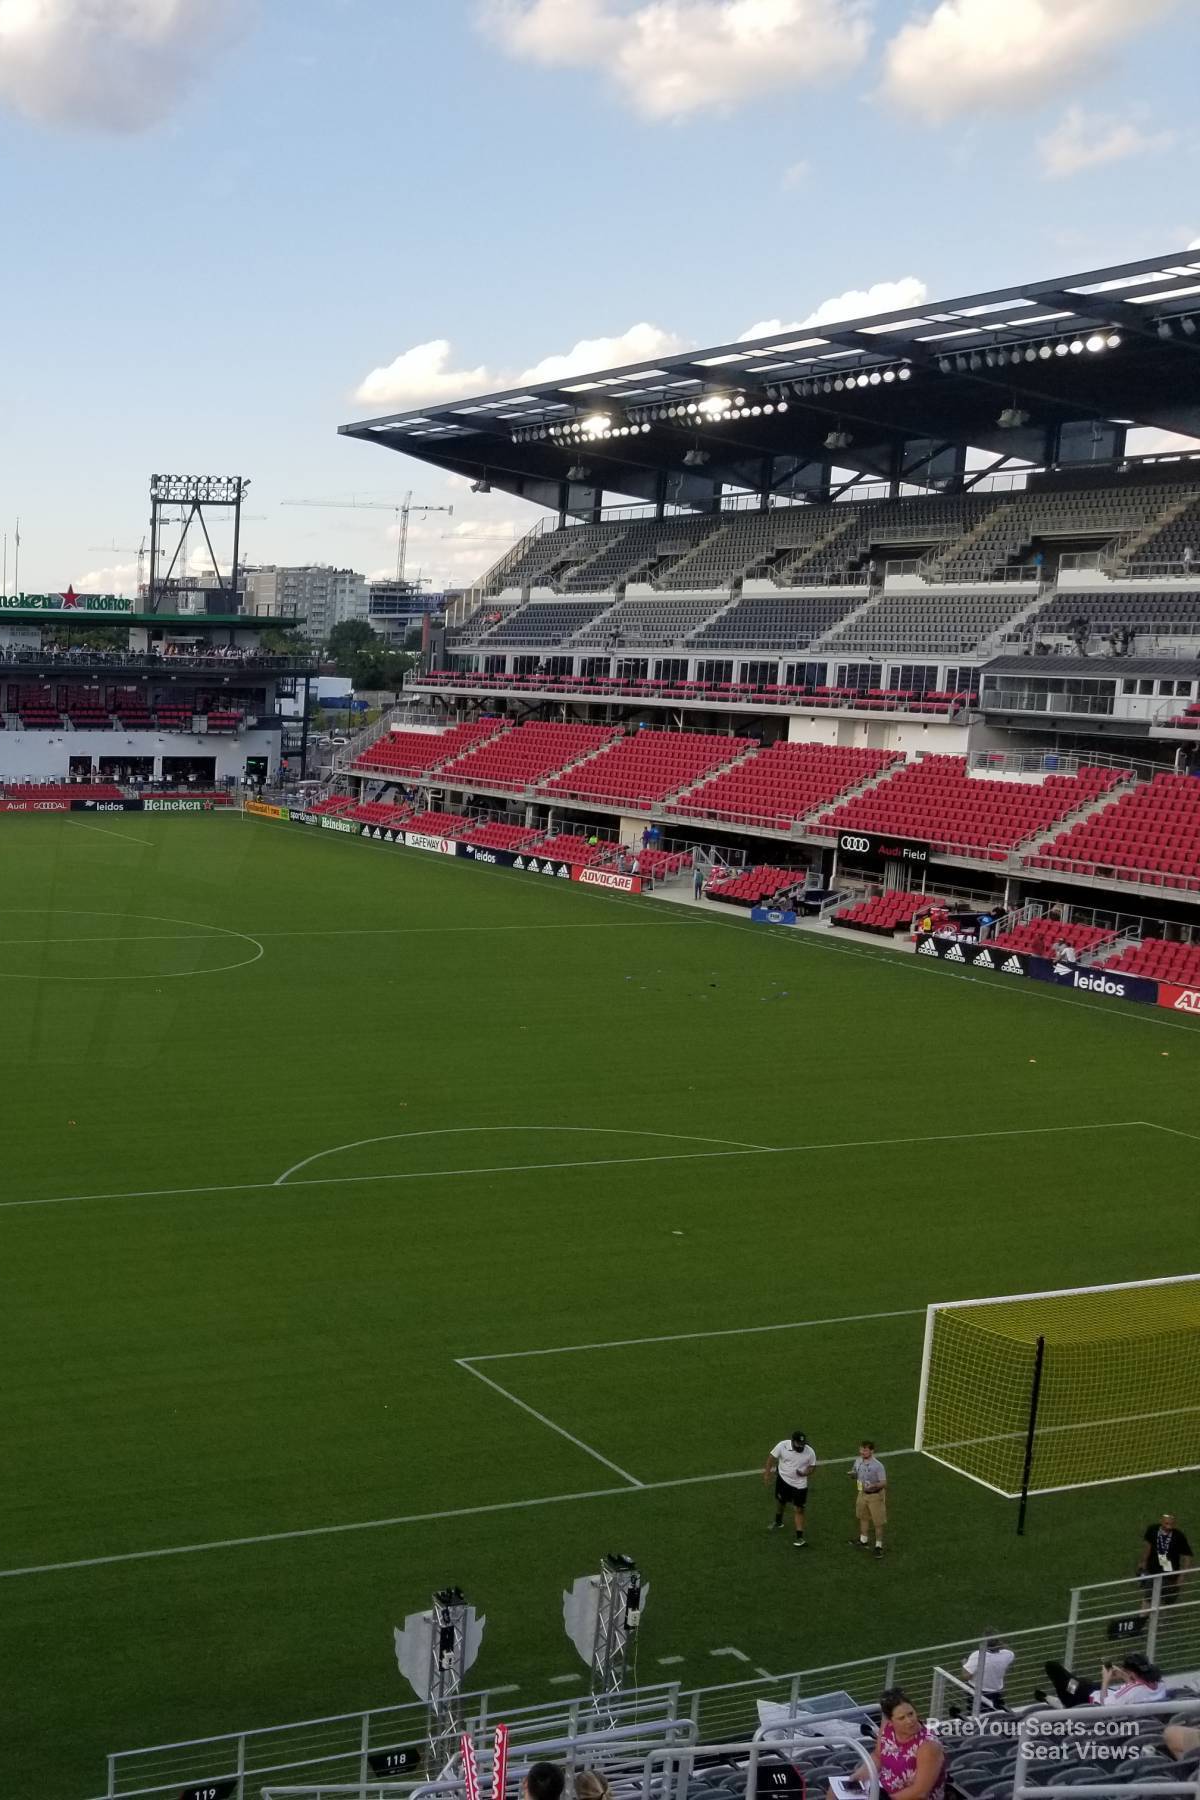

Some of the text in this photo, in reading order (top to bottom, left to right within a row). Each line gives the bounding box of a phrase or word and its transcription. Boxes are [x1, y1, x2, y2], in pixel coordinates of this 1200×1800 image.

[86, 598, 132, 611] ROOFTOP
[7, 802, 27, 810] Audi
[96, 802, 124, 811] leidos
[143, 799, 201, 811] Heineken
[321, 816, 351, 833] Heineken
[411, 835, 440, 849] SAFEWAY
[474, 849, 496, 864] leidos
[878, 845, 927, 861] Audi Field
[580, 870, 632, 889] ADVOCARE
[918, 947, 938, 957] adidas
[944, 953, 966, 963] adidas
[972, 959, 995, 969] adidas
[1000, 965, 1024, 975] adidas
[1073, 971, 1125, 996] leidos
[1119, 1621, 1134, 1632] 118
[386, 1754, 407, 1767] 118
[772, 1773, 787, 1785] 119
[194, 1788, 217, 1800] 119
